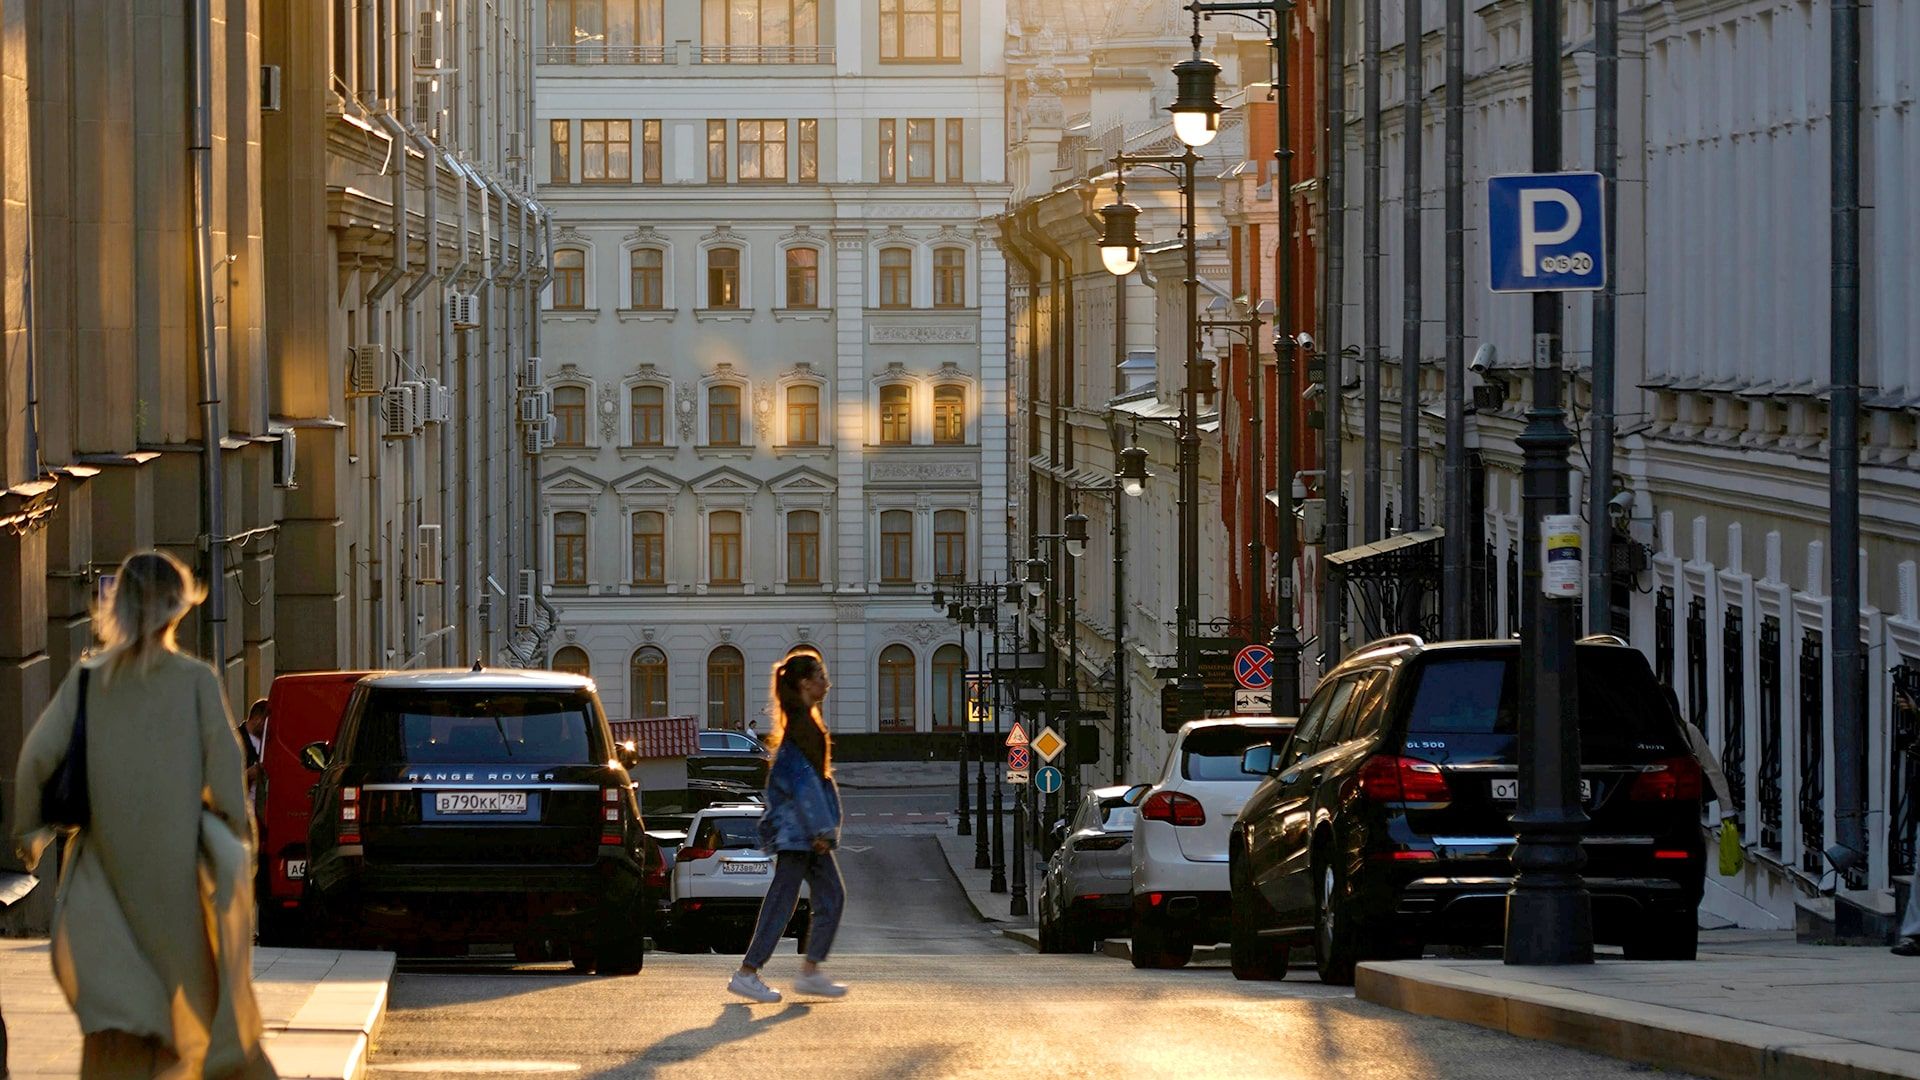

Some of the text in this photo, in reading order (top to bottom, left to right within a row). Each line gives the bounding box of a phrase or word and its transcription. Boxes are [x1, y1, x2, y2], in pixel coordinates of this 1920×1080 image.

[1519, 188, 1582, 277] P
[1573, 257, 1591, 270] 20
[408, 773, 555, 781] RANGE ROVER
